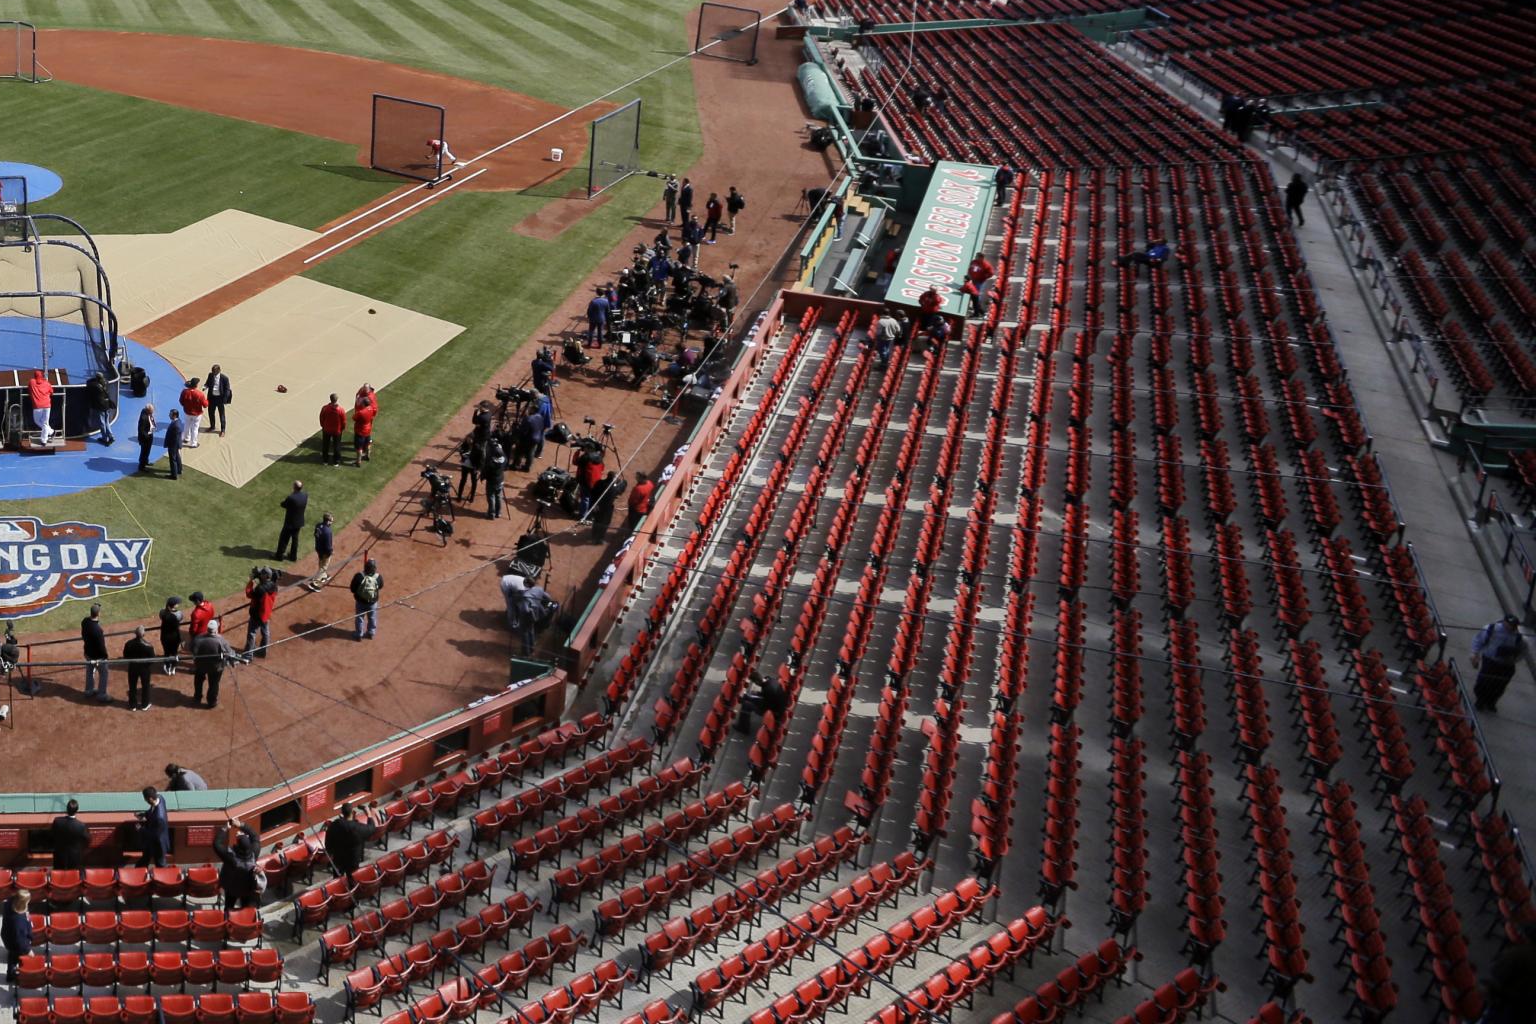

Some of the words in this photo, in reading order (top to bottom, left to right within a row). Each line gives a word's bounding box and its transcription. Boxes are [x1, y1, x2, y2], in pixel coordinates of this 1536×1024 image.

[936, 178, 980, 209] SOX
[925, 206, 972, 238] RED
[62, 538, 151, 572] DAY
